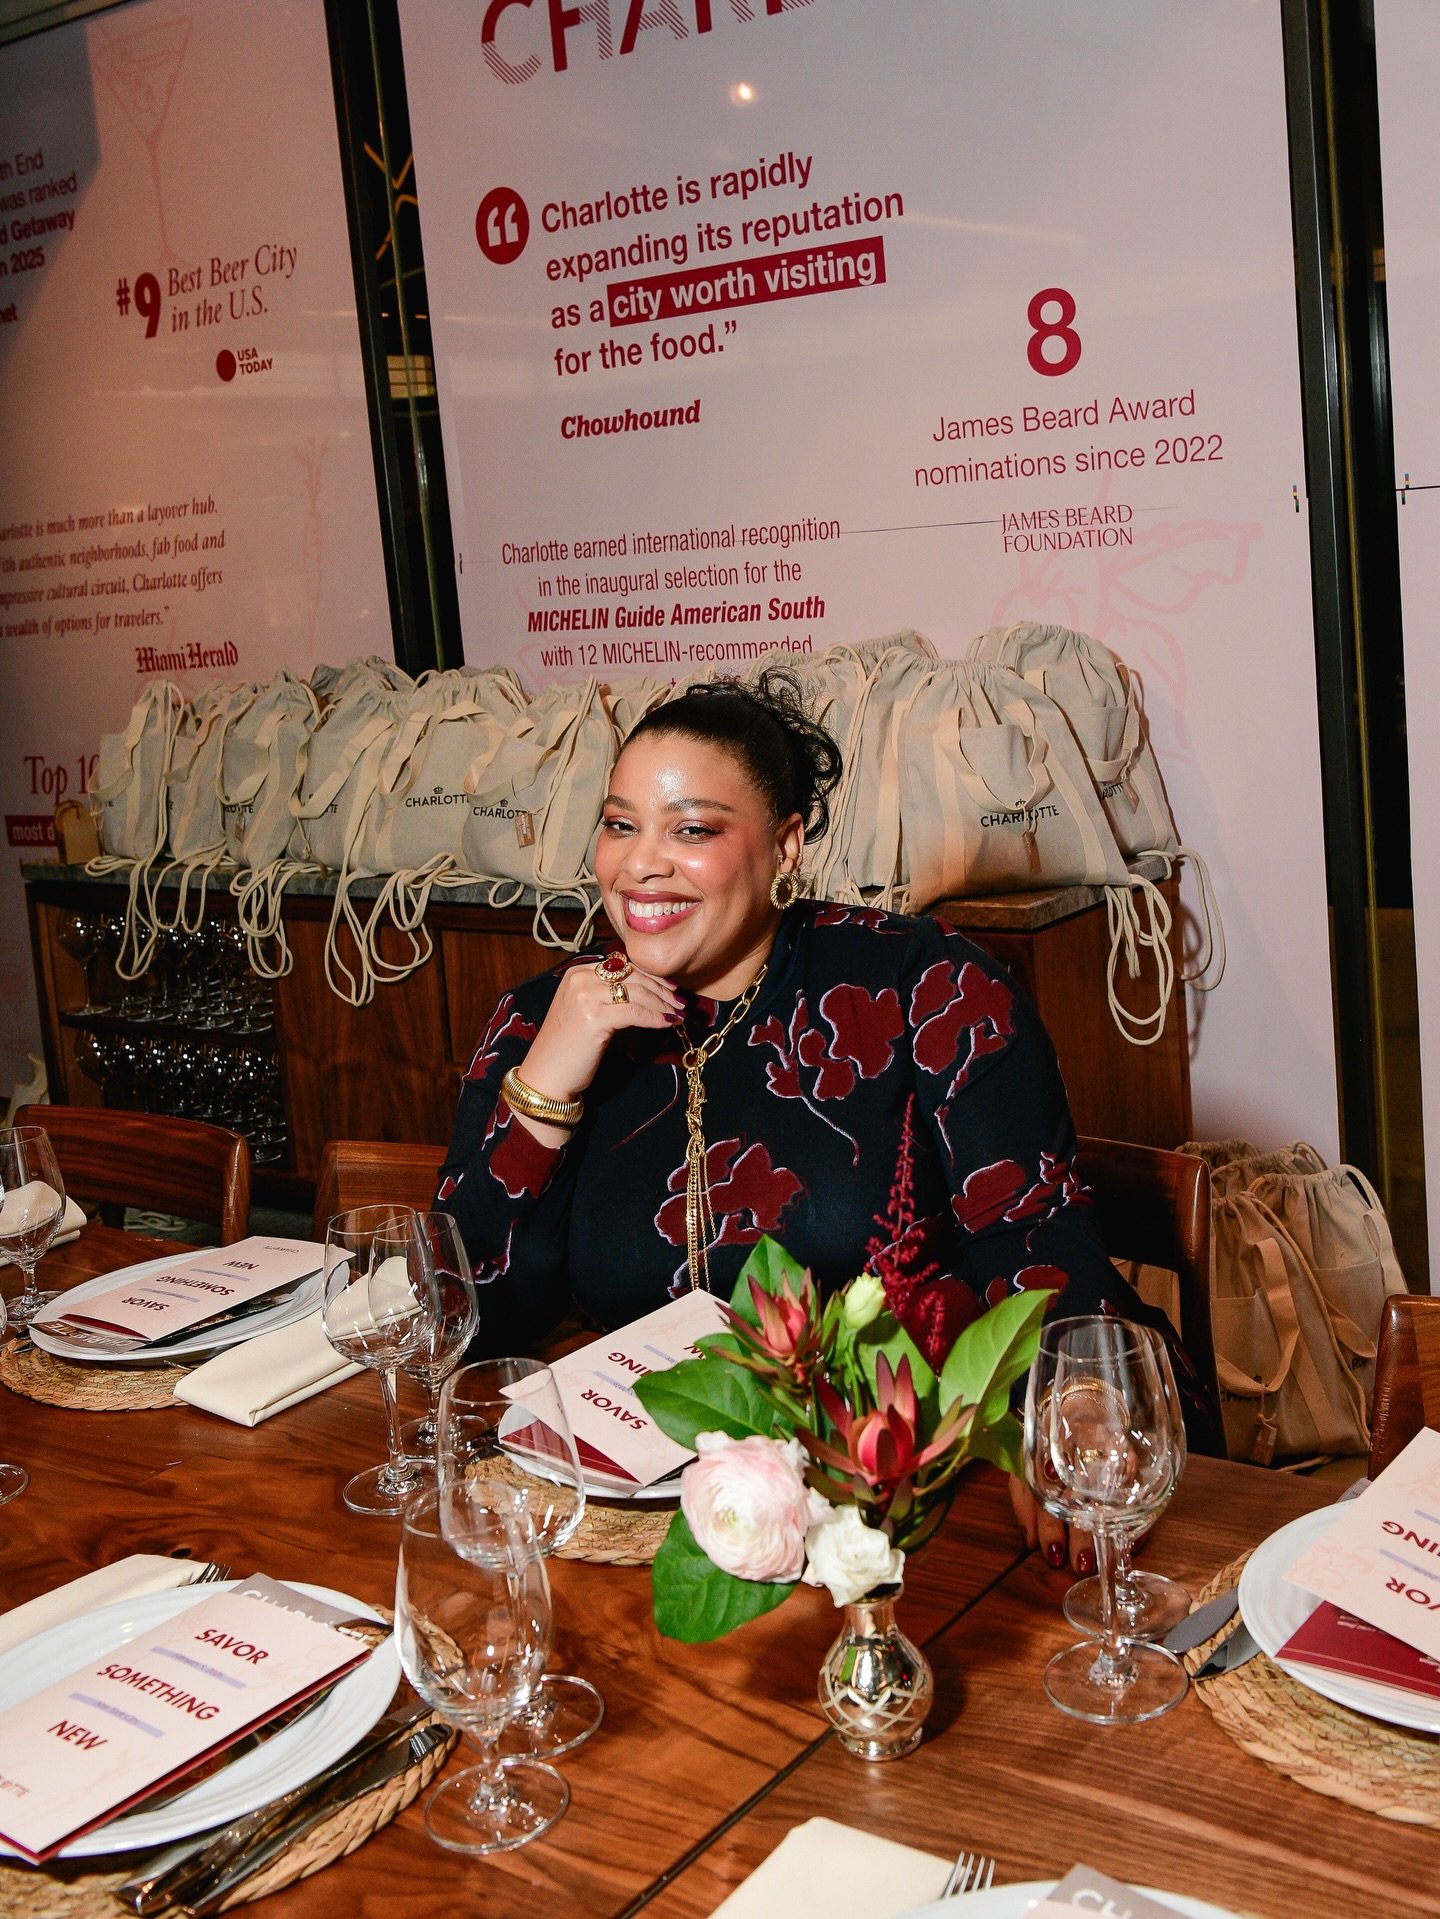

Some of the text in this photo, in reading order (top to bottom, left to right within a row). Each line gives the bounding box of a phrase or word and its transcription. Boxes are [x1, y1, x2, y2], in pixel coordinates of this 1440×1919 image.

[15, 149, 44, 176] End
[29, 170, 78, 203] ranked
[541, 152, 813, 233] Charlotte is rapidly
[11, 209, 75, 241] Getaway
[546, 193, 904, 282] expanding its reputation
[10, 247, 45, 273] 2025
[116, 244, 297, 339] #9 Best Beer City
[551, 251, 877, 329] as a city worth visiting
[171, 285, 268, 333] in the U.S.
[554, 320, 737, 376] for the food.”
[1027, 288, 1081, 376] 8
[237, 348, 258, 361] USA
[239, 358, 273, 375] TODAY
[561, 399, 701, 439] Chowhound
[933, 389, 1196, 441] James Beard Award
[915, 434, 1224, 486] nominations since 2022
[36, 520, 43, 537] is
[46, 515, 75, 535] much
[78, 514, 104, 530] more
[108, 509, 134, 526] than
[137, 512, 144, 523] a
[148, 504, 189, 526] layover
[192, 496, 218, 515] hub.
[1001, 504, 1133, 534] JAMES BEARD
[19, 550, 66, 571] authentic
[70, 540, 149, 568] neighborhoods,
[152, 537, 170, 561] fab
[173, 533, 198, 559] food
[202, 530, 225, 549] and
[502, 517, 841, 564] Charlotte earned international recognition
[1003, 528, 1133, 553] FOUNDATION
[47, 580, 88, 601] cultural
[91, 577, 129, 597] circuit,
[133, 571, 187, 593] Charlotte
[191, 566, 223, 592] offers
[538, 559, 802, 597] in the inaugural selection for the
[42, 616, 53, 638] of
[55, 614, 92, 637] options
[95, 611, 111, 634] for
[528, 596, 825, 632] MICHELIN Guide American South
[136, 641, 238, 673] Miami Herald
[541, 646, 573, 666] with
[579, 644, 597, 664] 12
[24, 755, 68, 805] Top
[12, 823, 44, 840] most
[223, 1260, 260, 1270] NEW
[121, 1296, 170, 1312] SAVOR
[155, 1276, 236, 1296] SOMETHING
[580, 1388, 648, 1430] SAVOR
[194, 1628, 269, 1665] SAVOR
[96, 1663, 220, 1721] SOMETHING
[47, 1719, 108, 1751] NEW
